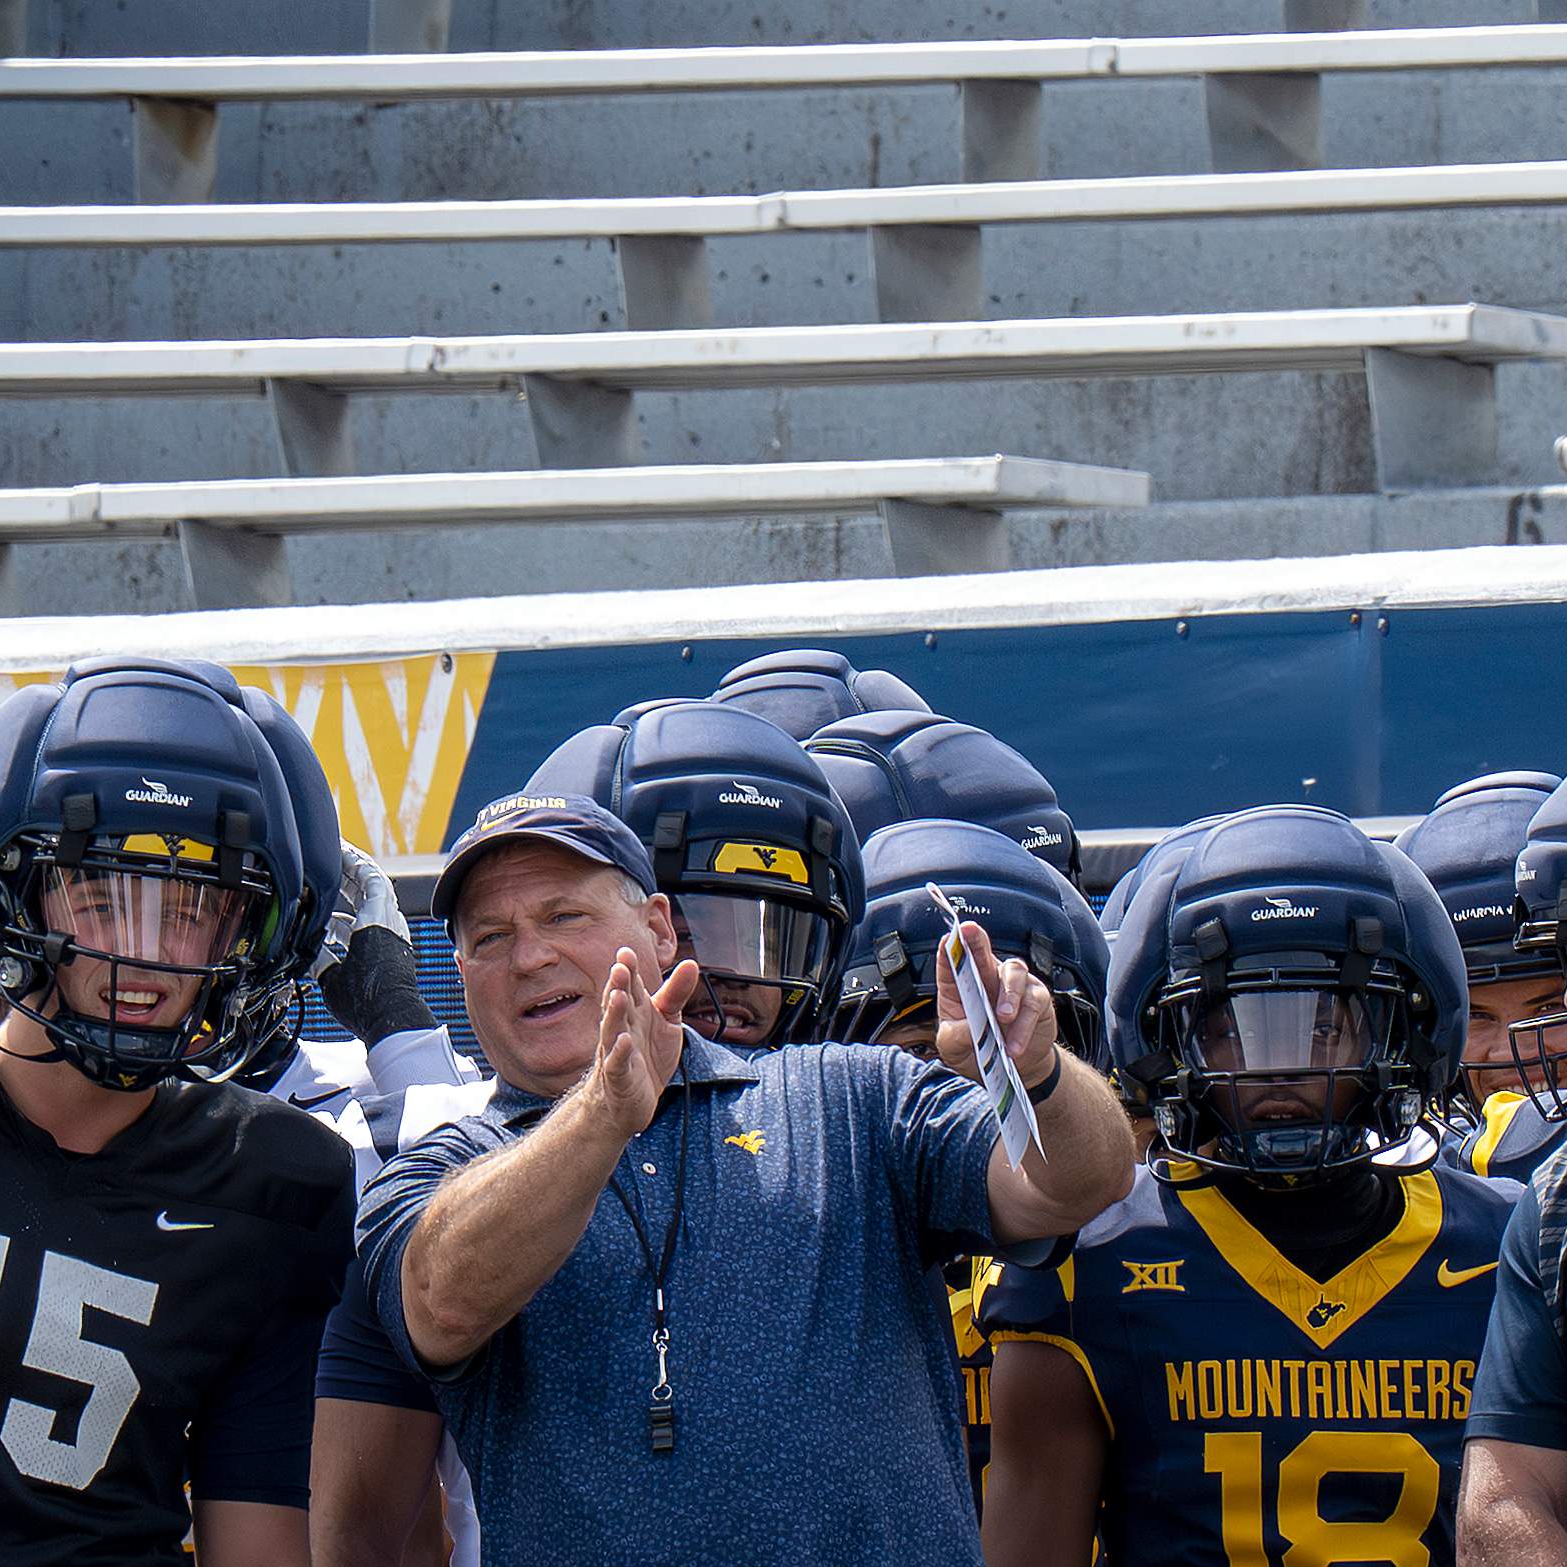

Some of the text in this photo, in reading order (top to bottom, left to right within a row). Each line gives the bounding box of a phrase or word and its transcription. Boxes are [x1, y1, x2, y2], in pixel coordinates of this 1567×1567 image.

[125, 789, 191, 807] GUARDIAN
[491, 796, 567, 817] VIRGINIA
[719, 793, 781, 809] GUARDIAN
[1020, 833, 1063, 851] GUARDIAN
[1251, 906, 1316, 921] GUARDIAN
[1165, 1359, 1475, 1421] MOUNTAINEERS
